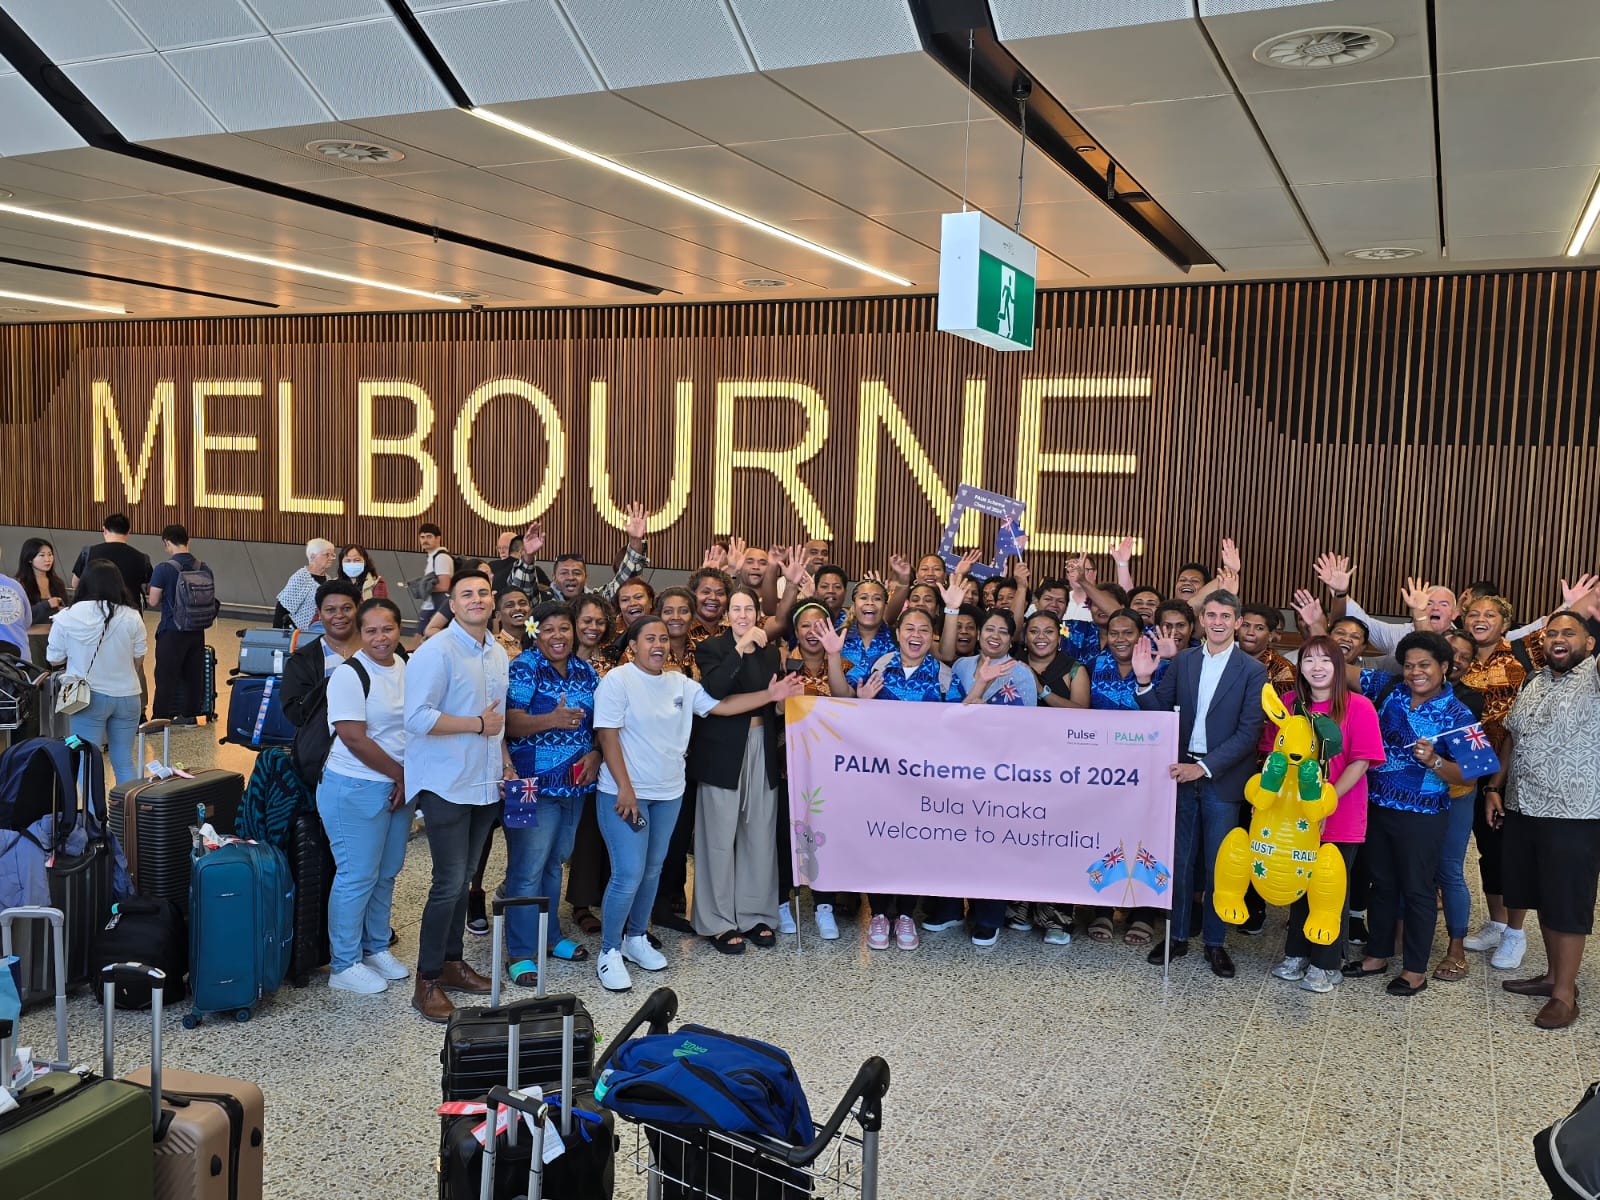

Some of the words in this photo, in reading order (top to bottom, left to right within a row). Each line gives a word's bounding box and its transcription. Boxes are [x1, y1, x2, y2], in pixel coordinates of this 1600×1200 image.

[91, 376, 1152, 556] MELBOURNE
[1067, 728, 1096, 741] Pulse
[1114, 731, 1145, 742] PALM
[834, 754, 890, 775] PALM
[898, 758, 986, 780] Scheme
[993, 762, 1053, 784] Class
[1059, 765, 1081, 785] of
[1087, 767, 1140, 787] 2024
[921, 795, 964, 816] Bula
[971, 798, 1047, 820] Vinaka
[866, 820, 967, 843] Welcome
[974, 826, 995, 844] to
[1002, 829, 1101, 850] Australia!
[1250, 840, 1275, 856] AUST
